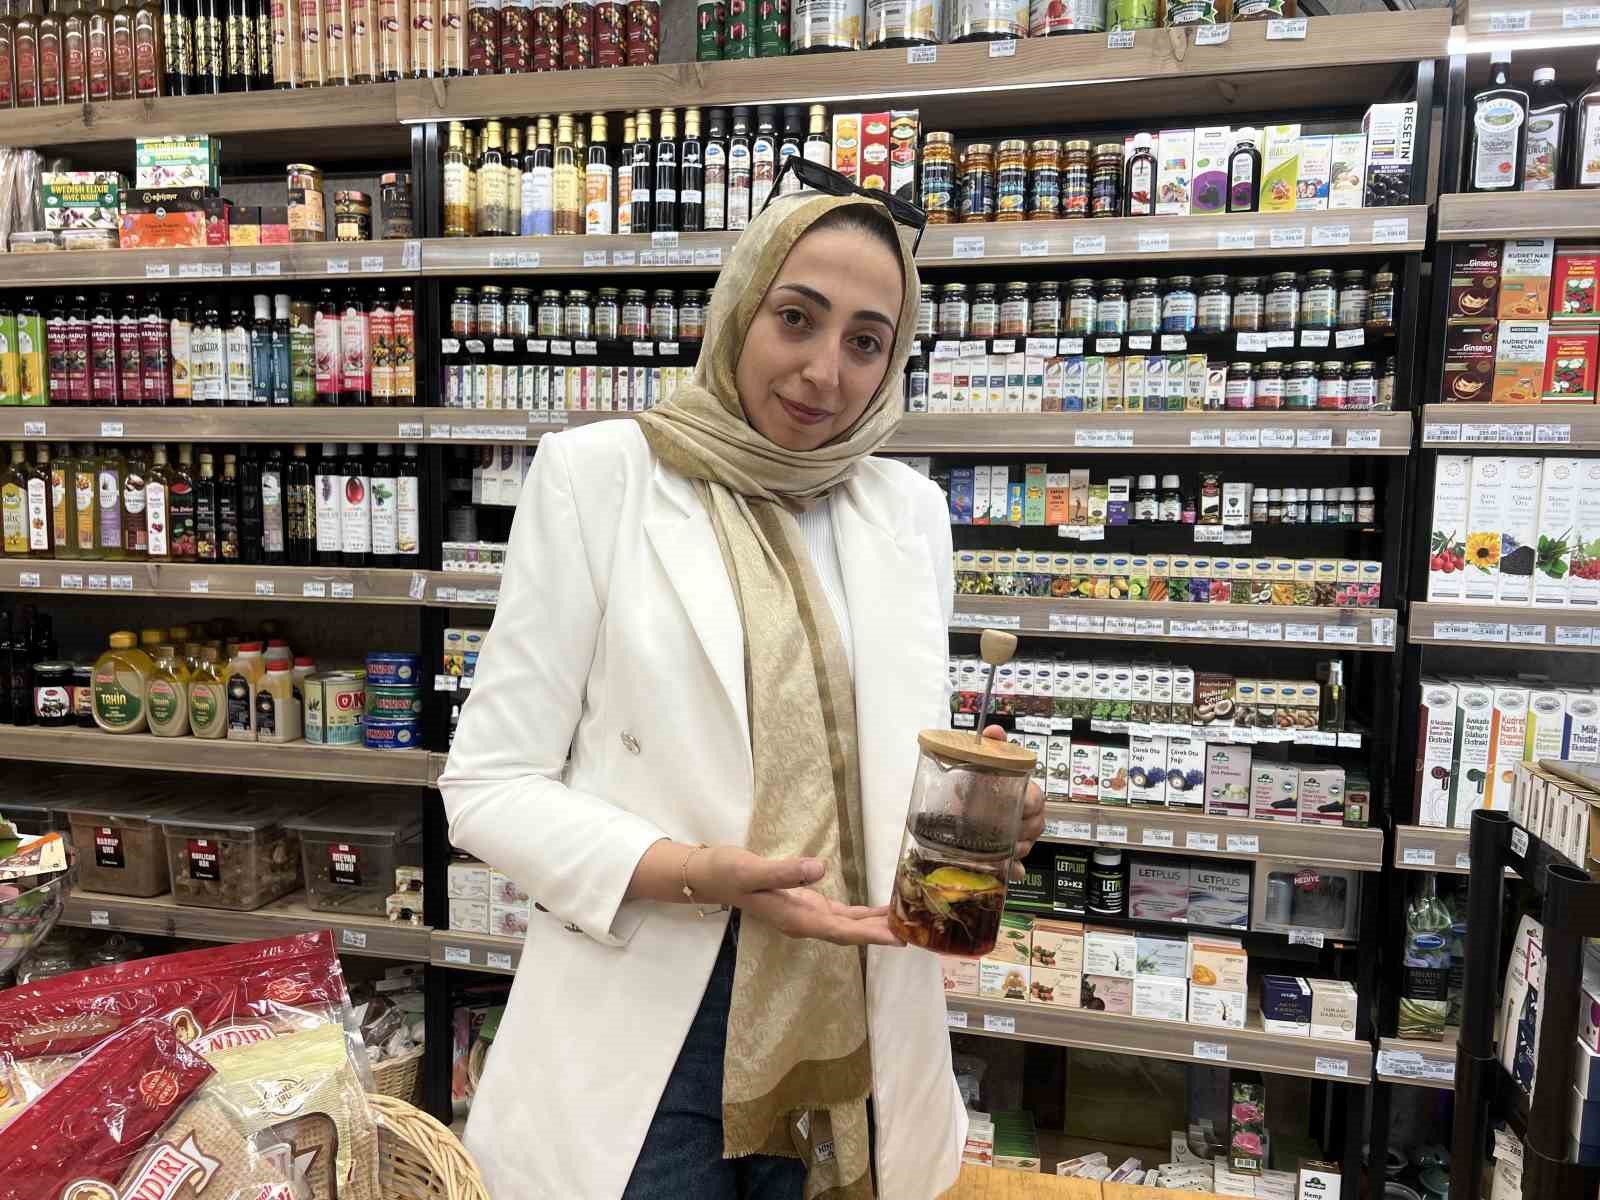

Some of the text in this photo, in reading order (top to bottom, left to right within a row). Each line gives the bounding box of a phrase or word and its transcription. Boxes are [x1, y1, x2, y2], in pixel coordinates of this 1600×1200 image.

[1400, 106, 1414, 160] RESETIN
[1469, 259, 1498, 268] Ginseng
[1463, 344, 1492, 352] Ginseng
[1581, 724, 1598, 734] Milk
[1428, 736, 1452, 744] Ekstrakt
[1464, 738, 1489, 746] Ekstrakt
[1573, 733, 1597, 744] Thistle
[1057, 861, 1085, 874] LETPLUS
[1138, 868, 1181, 880] LETPLUS
[1057, 879, 1083, 889] D3+K2
[1198, 873, 1241, 887] LETPLUS
